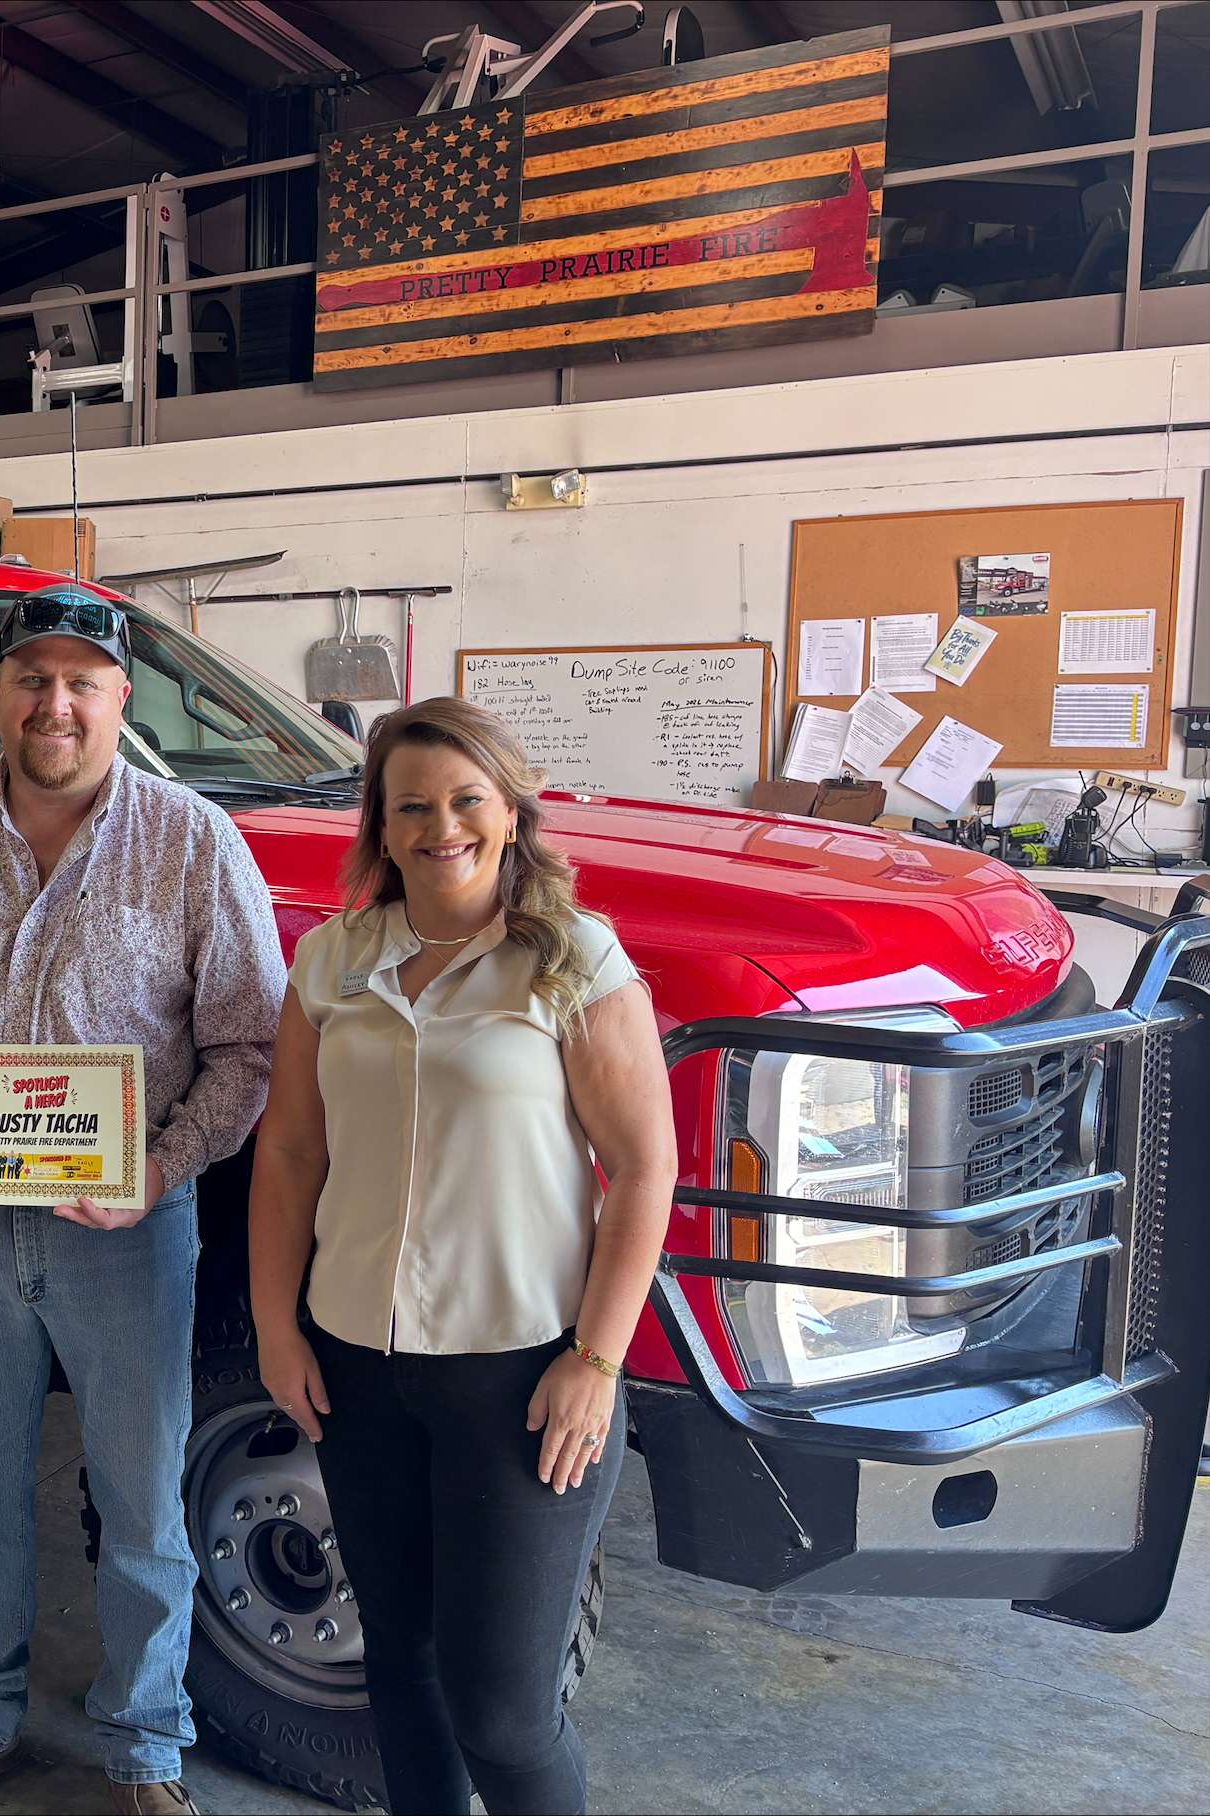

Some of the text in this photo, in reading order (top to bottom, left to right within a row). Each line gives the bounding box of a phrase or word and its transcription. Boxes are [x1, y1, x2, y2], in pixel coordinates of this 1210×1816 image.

[400, 227, 778, 301] PRETTY PRAIRIE FIRE
[570, 660, 613, 682] Dump
[615, 658, 647, 678] Site
[700, 656, 736, 671] 91100
[696, 673, 724, 684] siren
[12, 1075, 70, 1095] SPOTLIGHT
[24, 1091, 68, 1110] A HERO!
[46, 1113, 99, 1134] TACHA
[12, 1137, 38, 1147] PRAIRIE
[38, 1137, 53, 1147] FIRE
[54, 1138, 98, 1147] DEPARTMENT
